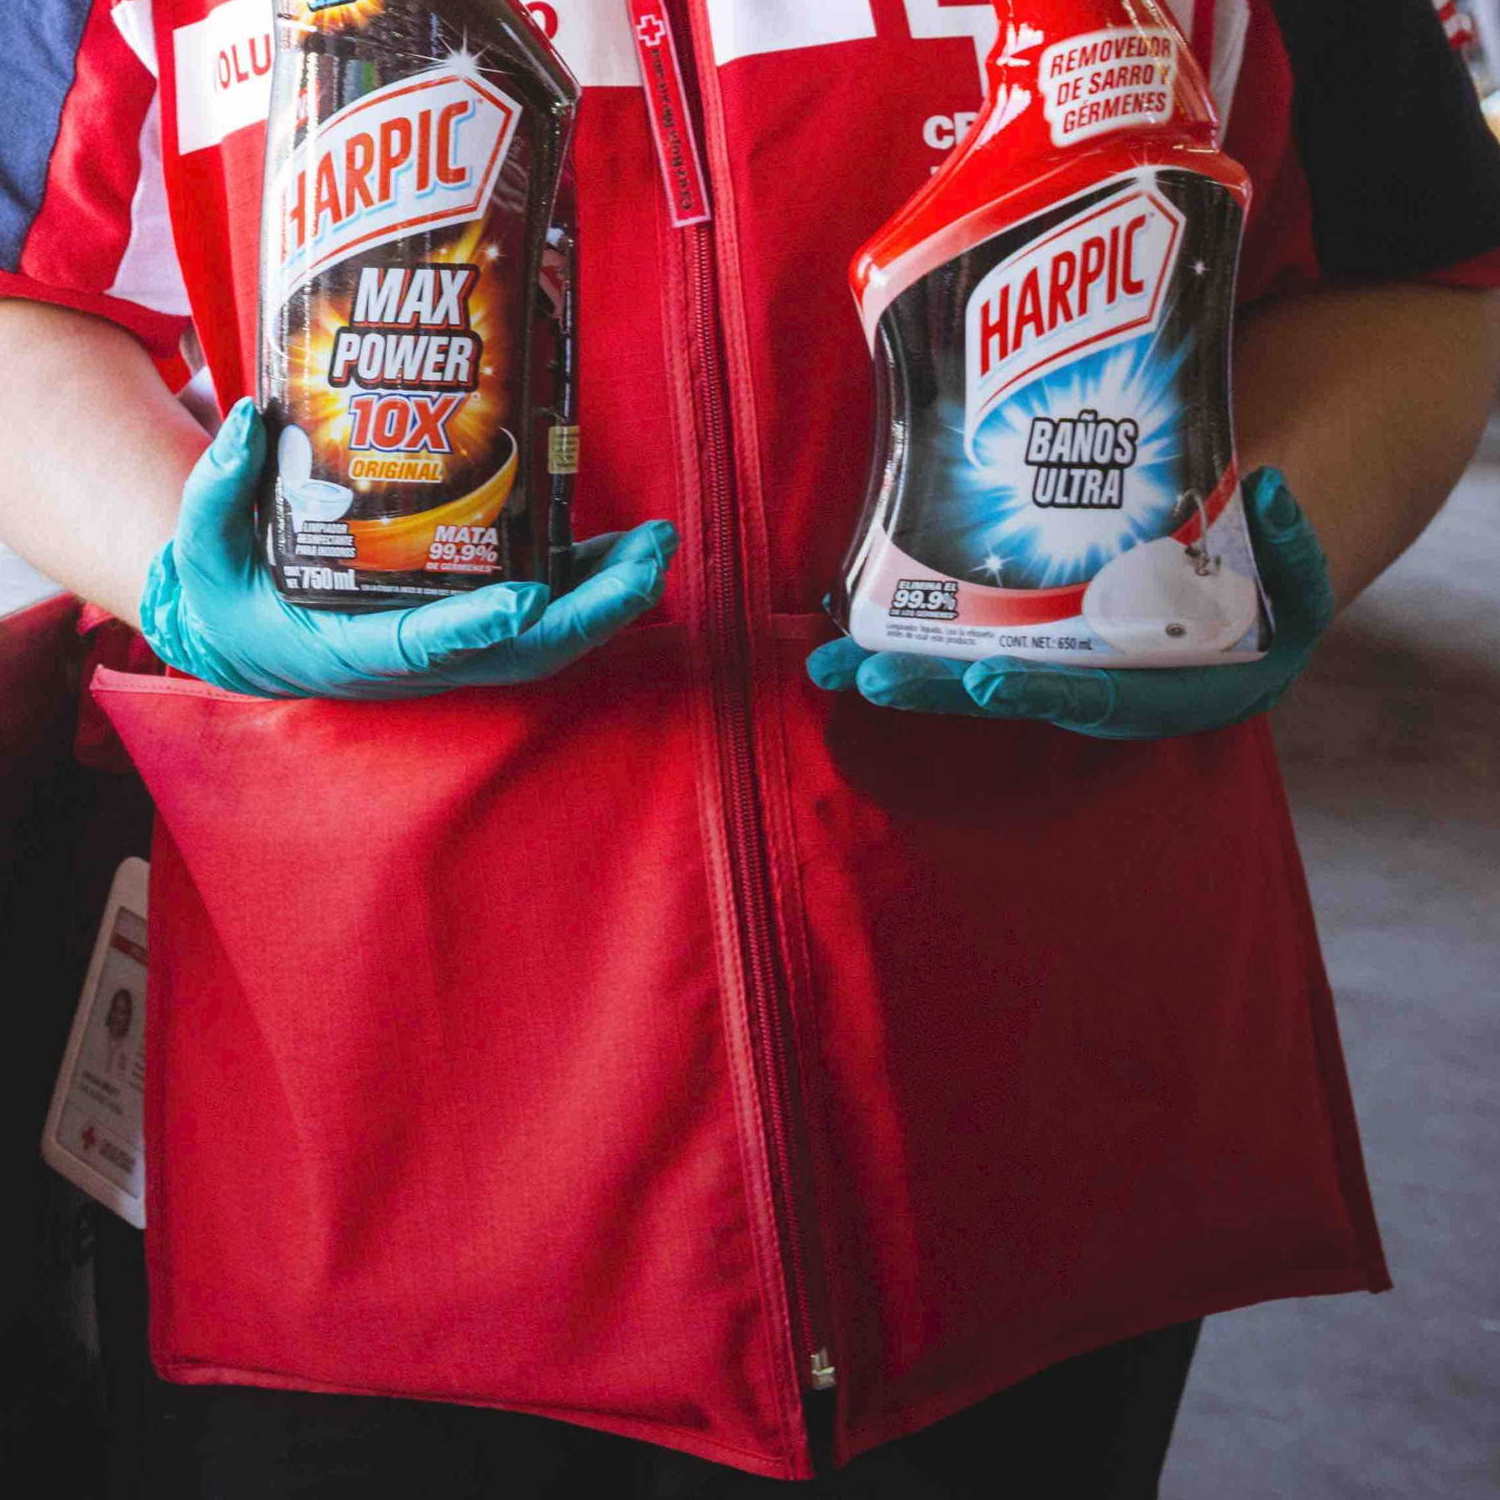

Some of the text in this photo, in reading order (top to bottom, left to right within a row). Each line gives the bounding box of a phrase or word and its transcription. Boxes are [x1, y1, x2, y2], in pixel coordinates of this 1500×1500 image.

[1050, 35, 1172, 78] REMOVEDOR
[1056, 64, 1171, 106] DE SARRO Y
[1062, 92, 1167, 134] GÉRMENES
[282, 100, 470, 264] HARPIC
[353, 266, 471, 326] MAX
[979, 213, 1147, 377] HARPIC
[332, 332, 474, 385] POWER
[350, 394, 461, 452] 10X
[1027, 411, 1137, 465] BAÑOS
[350, 458, 442, 482] ORIGINAL
[1034, 467, 1123, 507] ULTRA
[428, 542, 498, 563] 99,9%
[434, 524, 500, 545] MATA
[299, 566, 334, 589] 750
[892, 589, 958, 611] 99.9%
[998, 634, 1028, 649] CONT.
[1057, 636, 1077, 650] 650
[1078, 637, 1093, 651] mL
